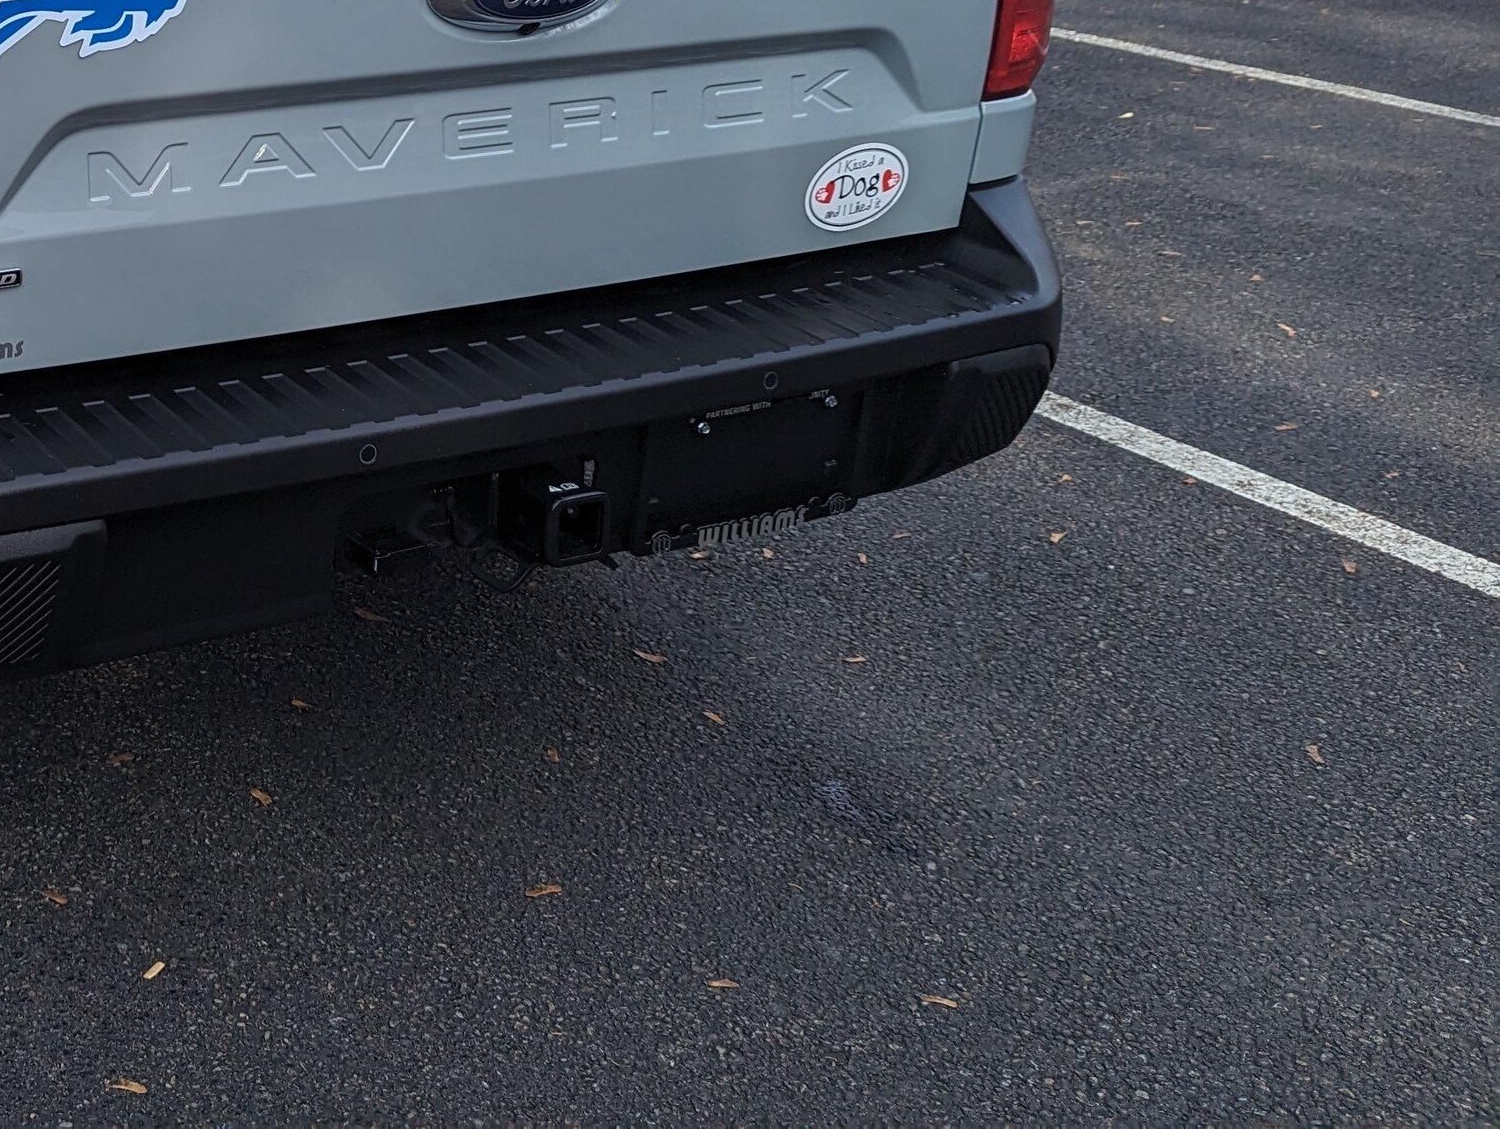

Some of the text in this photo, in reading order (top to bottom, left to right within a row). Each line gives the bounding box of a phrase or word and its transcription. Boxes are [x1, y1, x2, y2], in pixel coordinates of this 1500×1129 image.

[86, 68, 854, 203] MAVERICK
[833, 173, 880, 199] Dog
[697, 505, 808, 547] WILLIAMS
